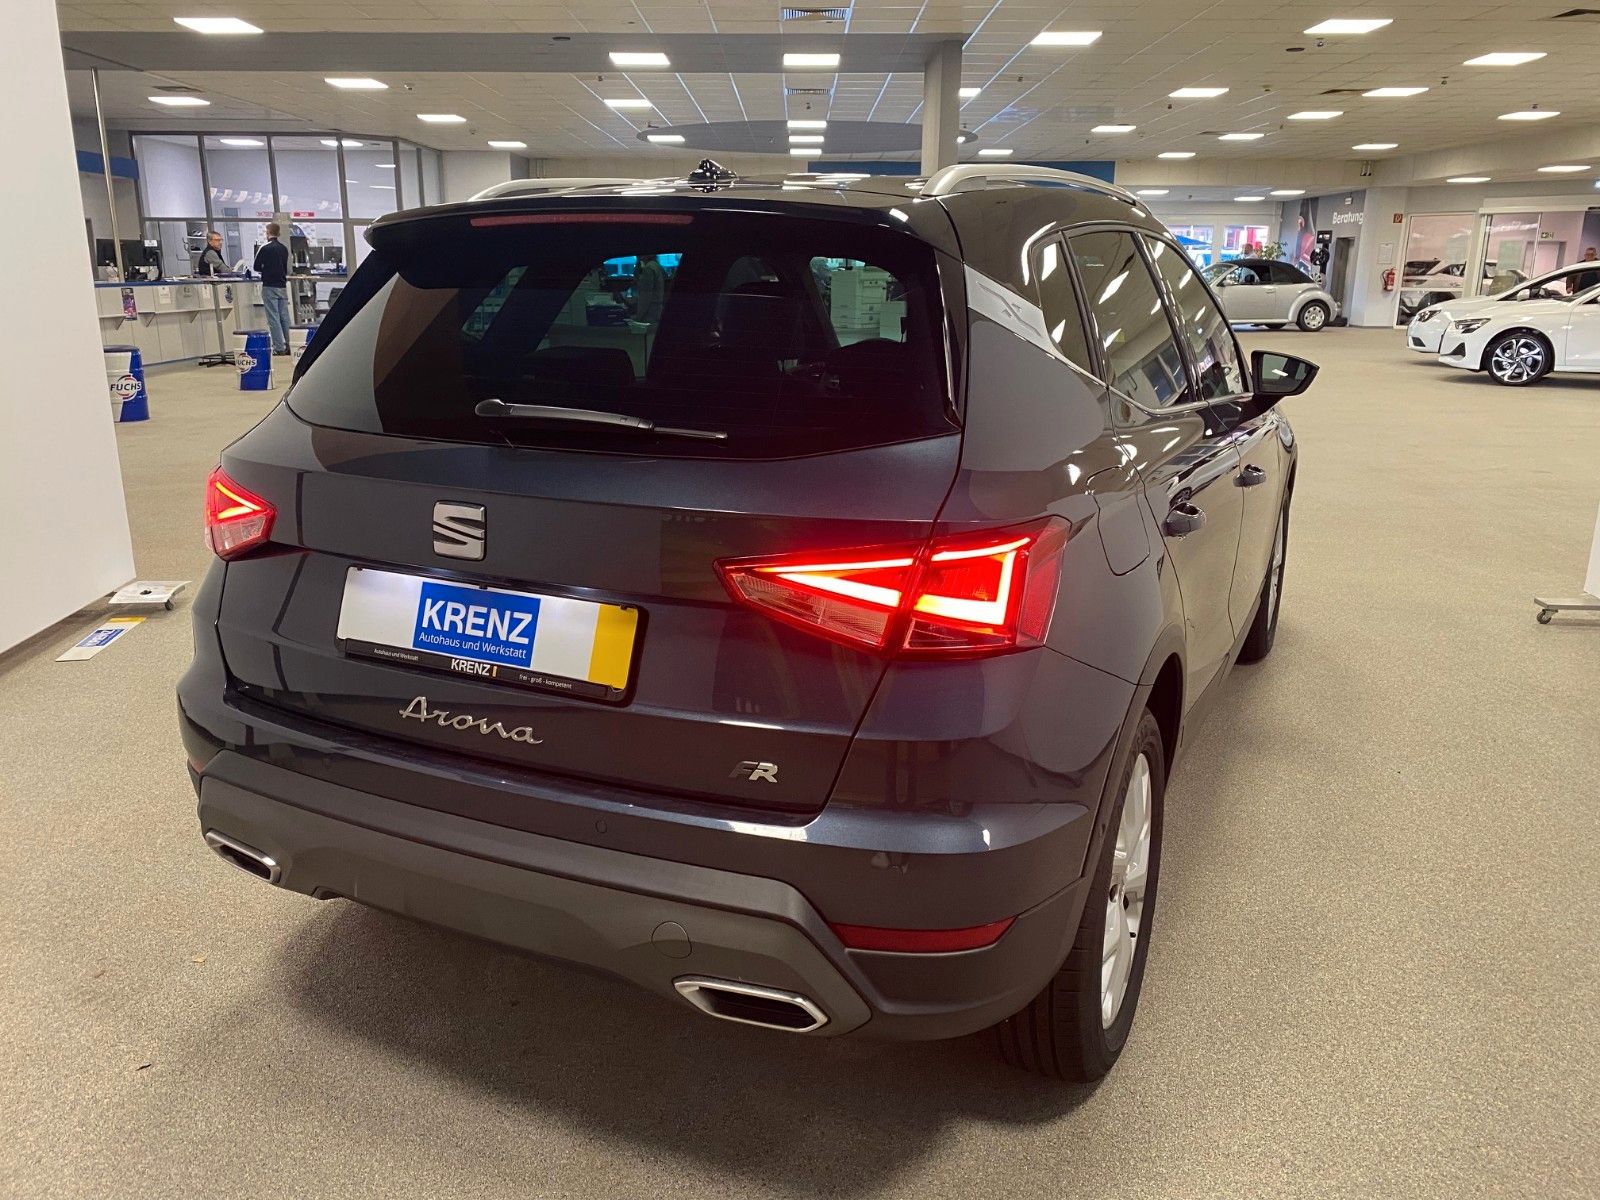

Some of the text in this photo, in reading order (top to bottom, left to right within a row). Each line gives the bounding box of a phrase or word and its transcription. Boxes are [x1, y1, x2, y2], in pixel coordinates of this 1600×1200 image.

[1332, 212, 1364, 224] Beratung
[110, 382, 142, 391] FUCHS
[422, 598, 532, 645] KRENZ
[418, 632, 526, 659] Autohaus und Werkstatt
[450, 658, 491, 676] KRENZ
[399, 696, 544, 744] Arona
[729, 760, 778, 783] FR
